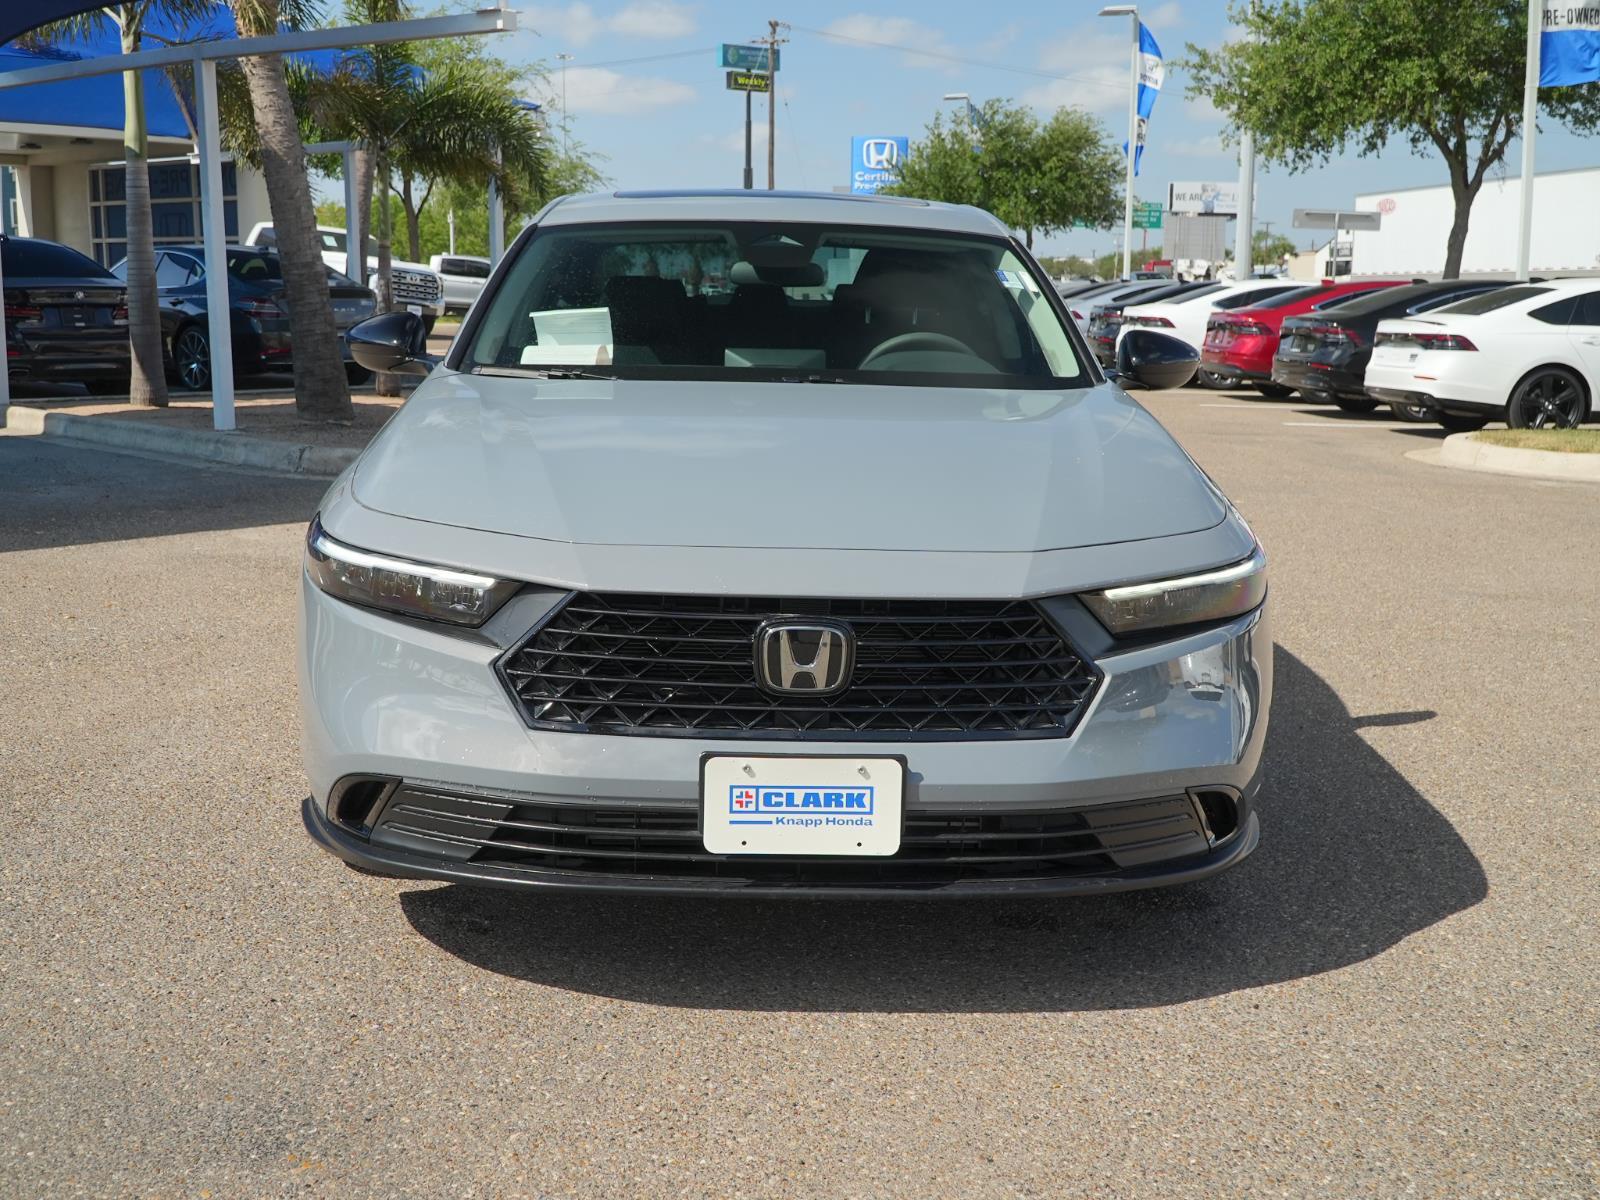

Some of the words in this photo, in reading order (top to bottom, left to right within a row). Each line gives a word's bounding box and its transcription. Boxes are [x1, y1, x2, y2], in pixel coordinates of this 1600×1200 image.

[762, 792, 867, 808] CLARK
[775, 816, 823, 828] Knapp
[825, 817, 873, 827] Honda
